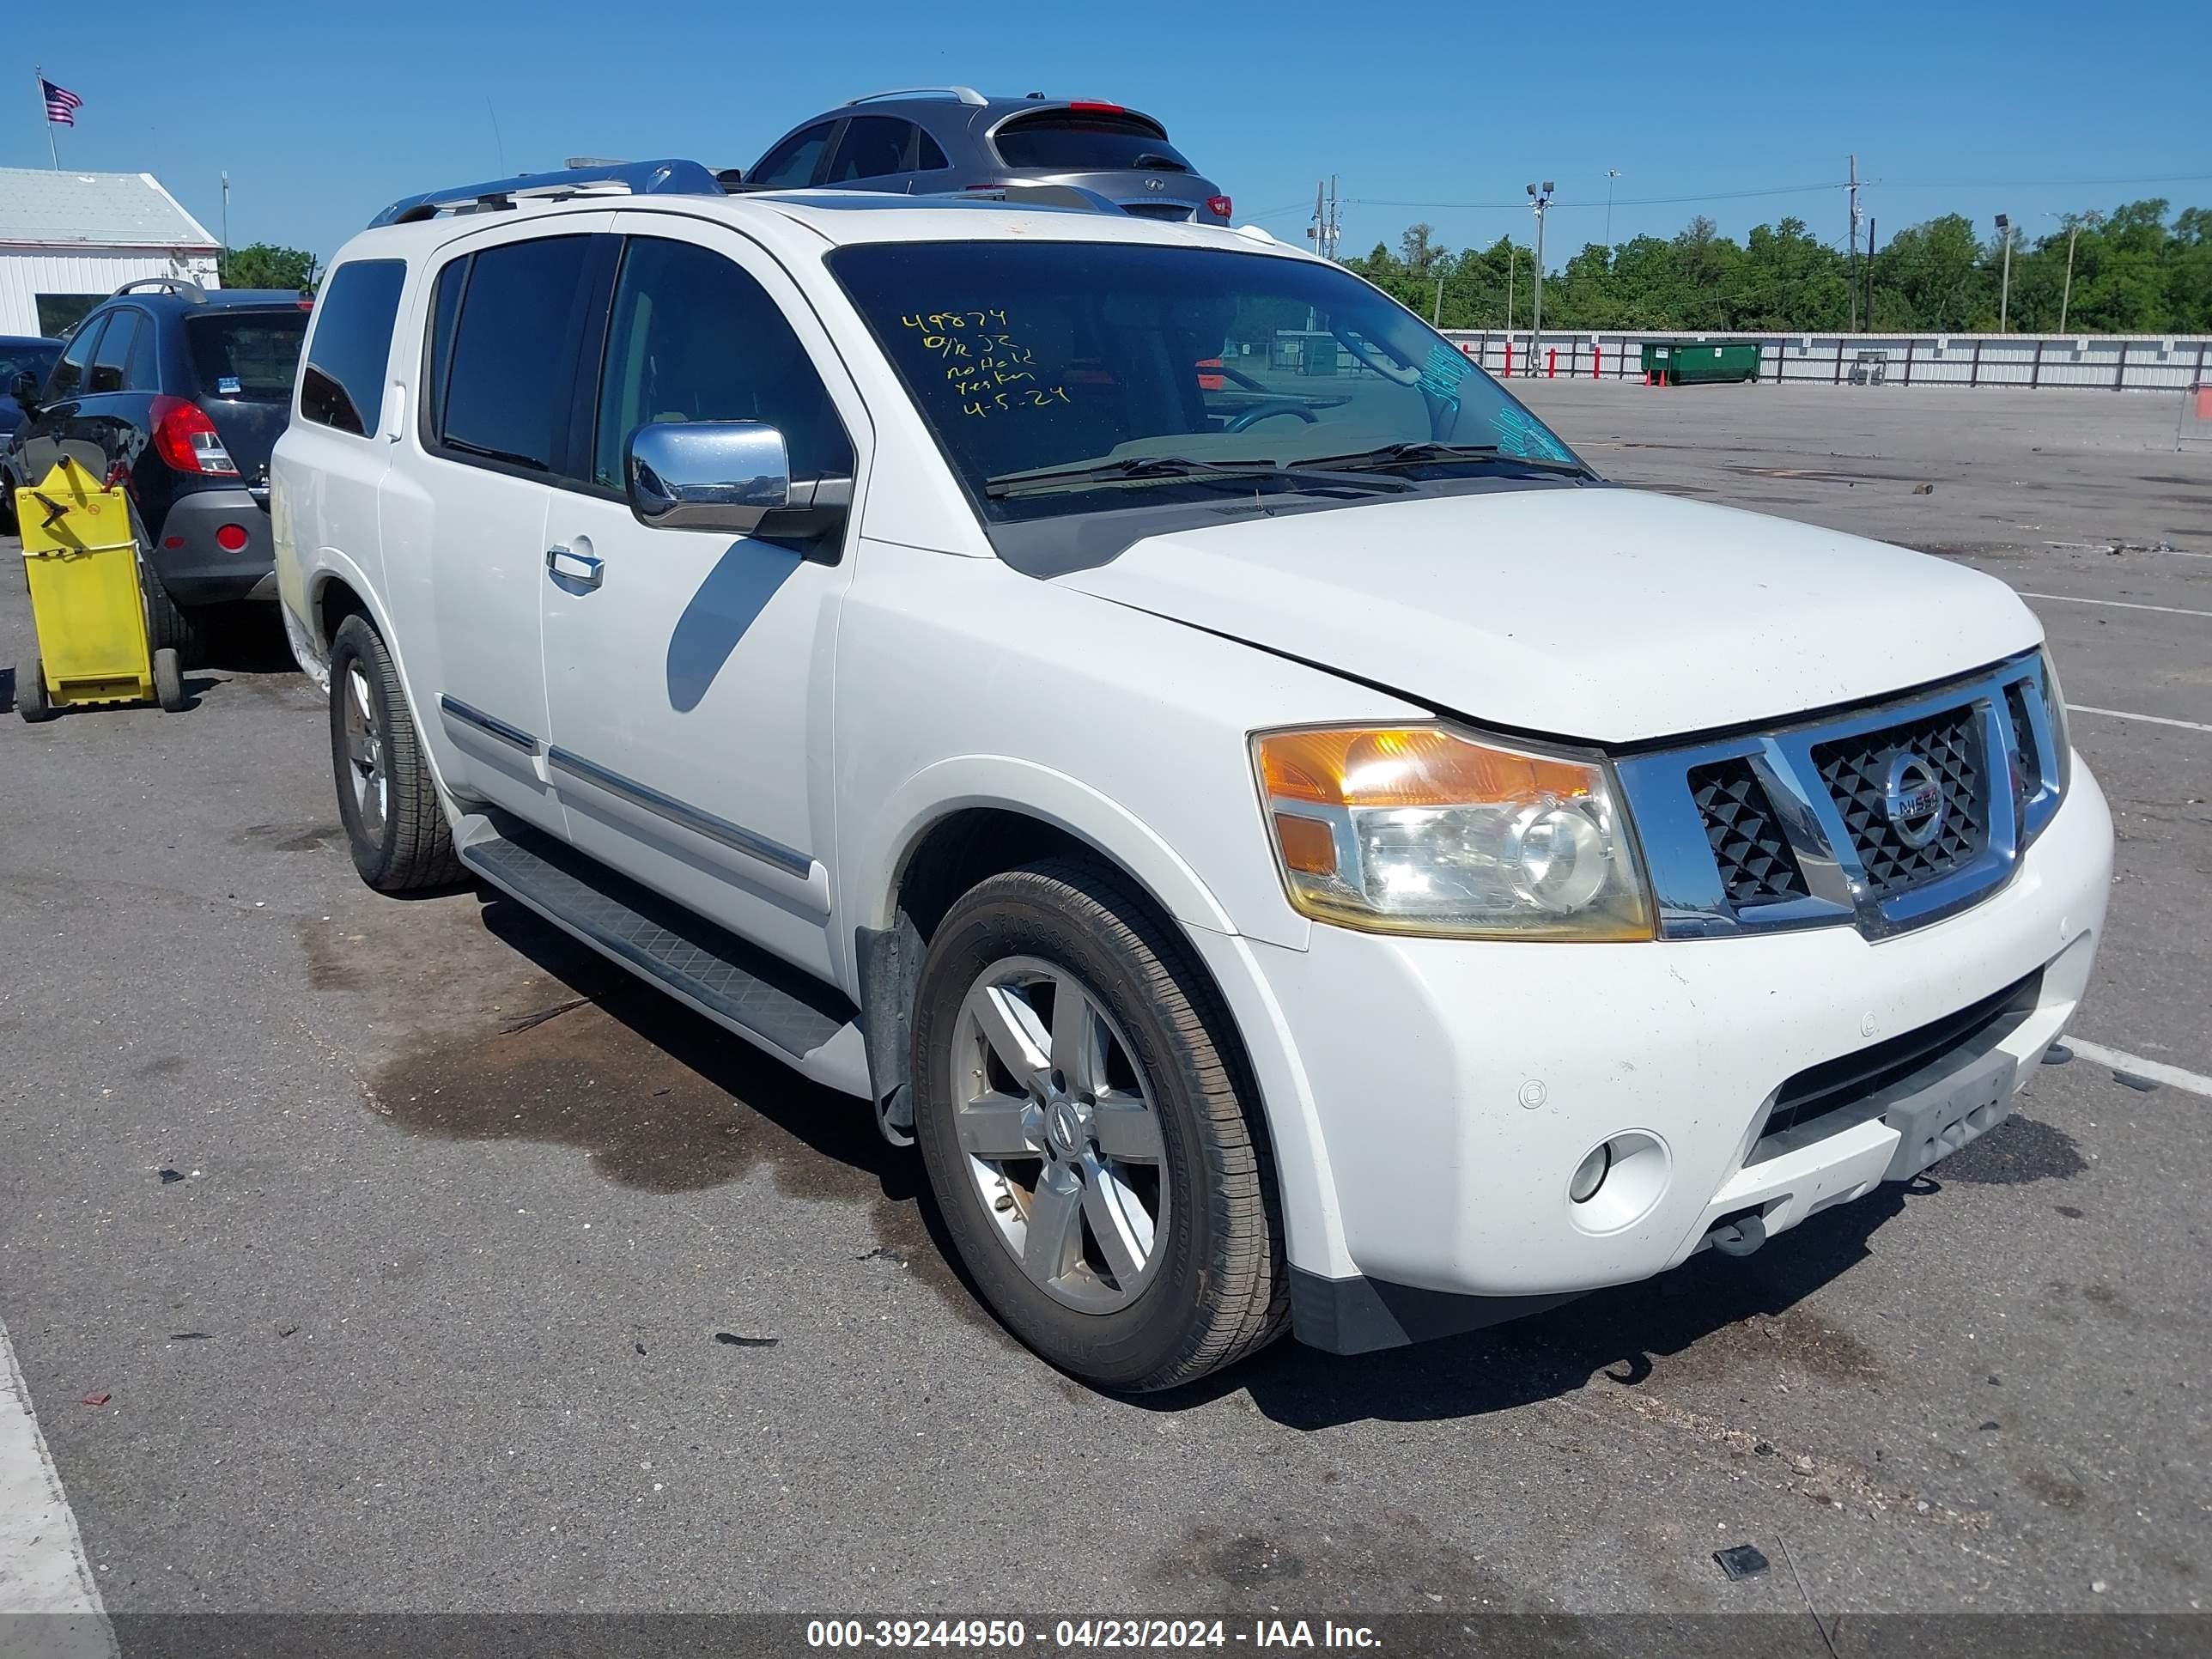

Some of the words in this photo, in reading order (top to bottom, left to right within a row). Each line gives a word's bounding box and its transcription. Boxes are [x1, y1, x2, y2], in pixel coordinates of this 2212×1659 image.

[902, 310, 1007, 333] 49874
[963, 386, 1071, 417] 4-5-24
[1899, 792, 1938, 815] NISSA
[995, 913, 1124, 1012] Firestone
